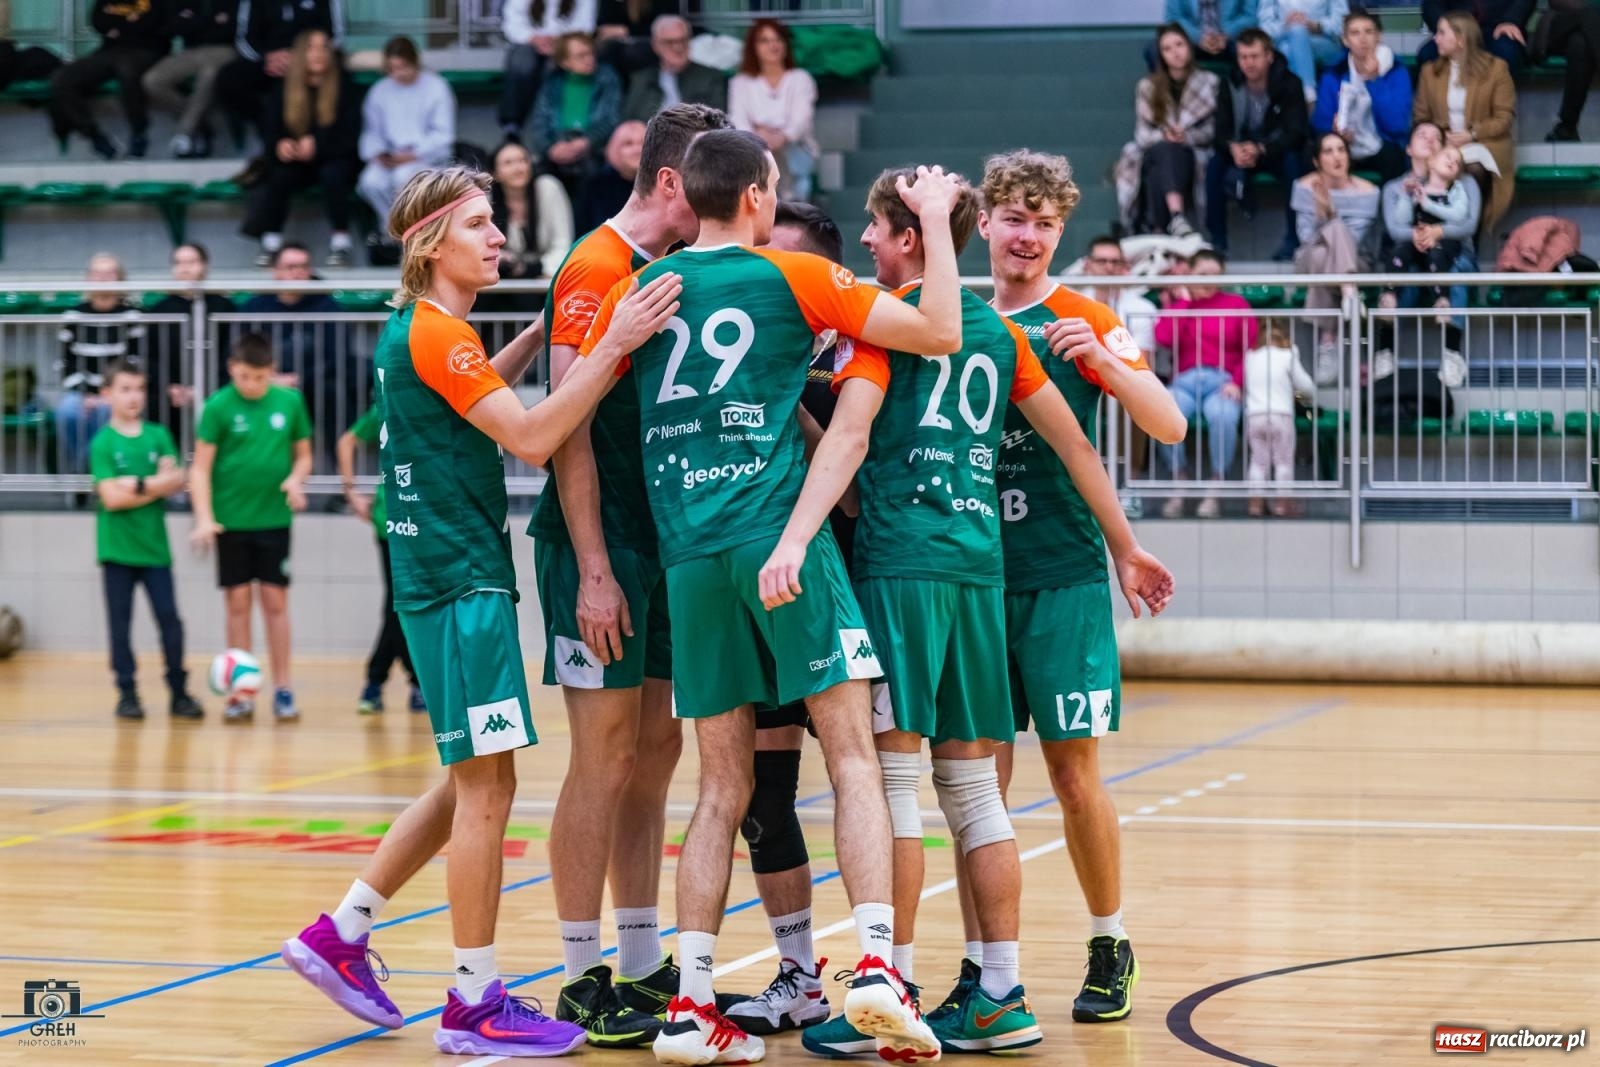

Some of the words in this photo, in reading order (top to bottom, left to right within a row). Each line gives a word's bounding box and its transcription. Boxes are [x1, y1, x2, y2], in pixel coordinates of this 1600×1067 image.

[656, 307, 755, 404] 29
[918, 353, 999, 435] 20
[661, 418, 702, 440] Nemak
[722, 410, 761, 424] TORK
[718, 433, 744, 443] Think
[745, 432, 776, 442] ahead.
[1056, 691, 1090, 731] 12
